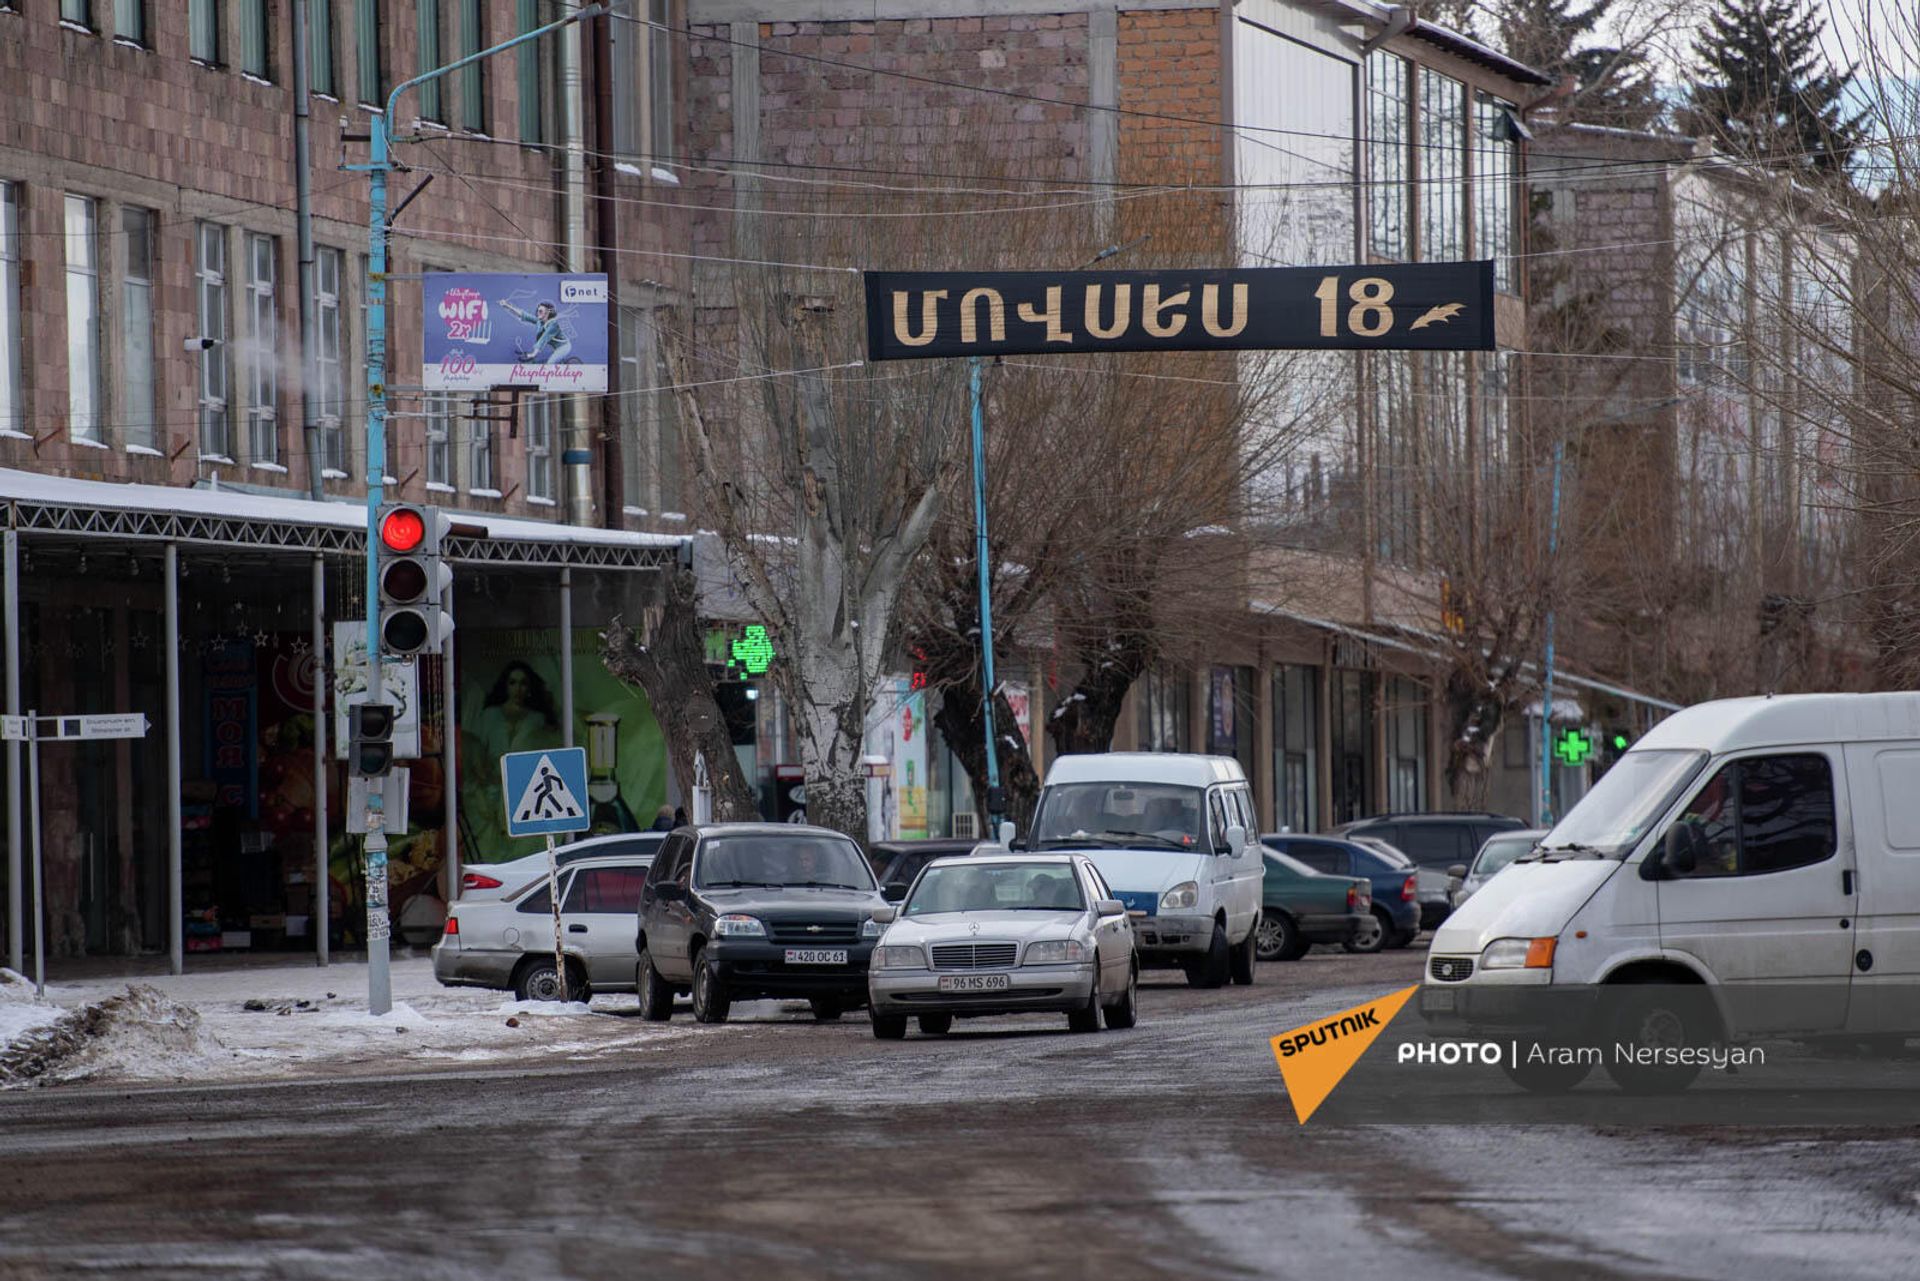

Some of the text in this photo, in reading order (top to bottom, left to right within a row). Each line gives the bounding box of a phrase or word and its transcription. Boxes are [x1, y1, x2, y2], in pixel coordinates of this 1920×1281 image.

[891, 276, 1395, 347] ՄՈՎՍԵՍ 18
[447, 321, 472, 339] 2x
[440, 355, 475, 374] 100
[798, 951, 815, 962] 420
[833, 951, 844, 962] 61
[953, 978, 966, 989] 96
[986, 977, 1005, 988] 696
